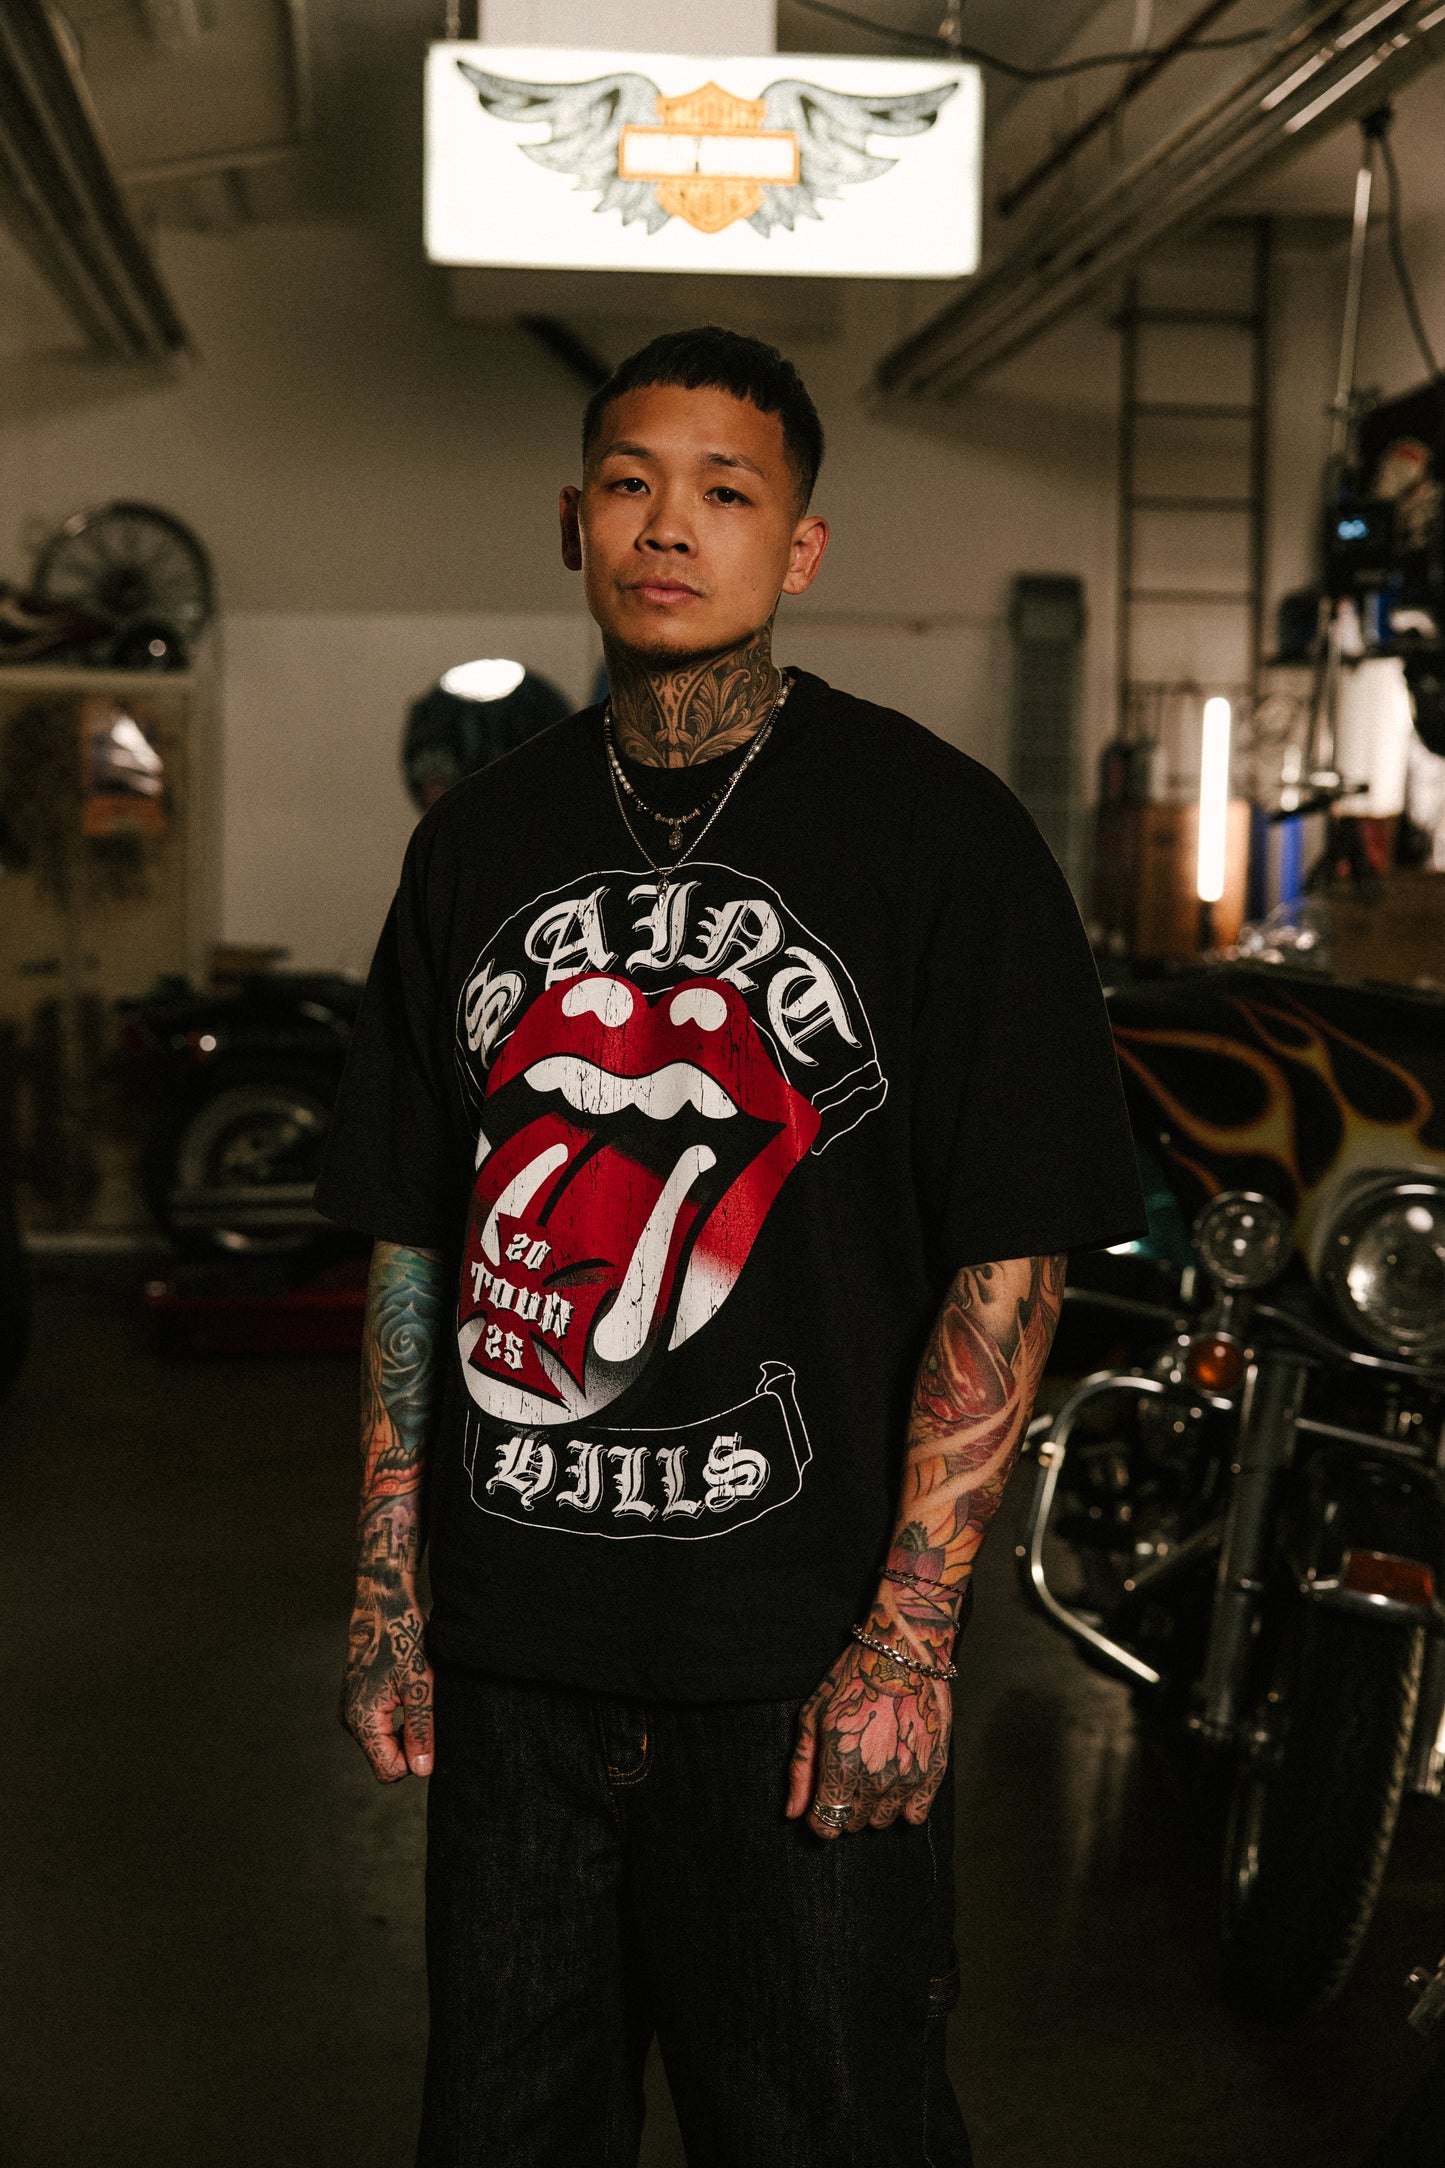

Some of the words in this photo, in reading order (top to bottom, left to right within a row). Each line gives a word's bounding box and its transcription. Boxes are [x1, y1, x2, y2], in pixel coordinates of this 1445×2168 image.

[466, 880, 862, 1069] SAINT
[505, 1233, 551, 1270] 20
[470, 1261, 574, 1339] TOUR
[484, 1324, 524, 1370] 25
